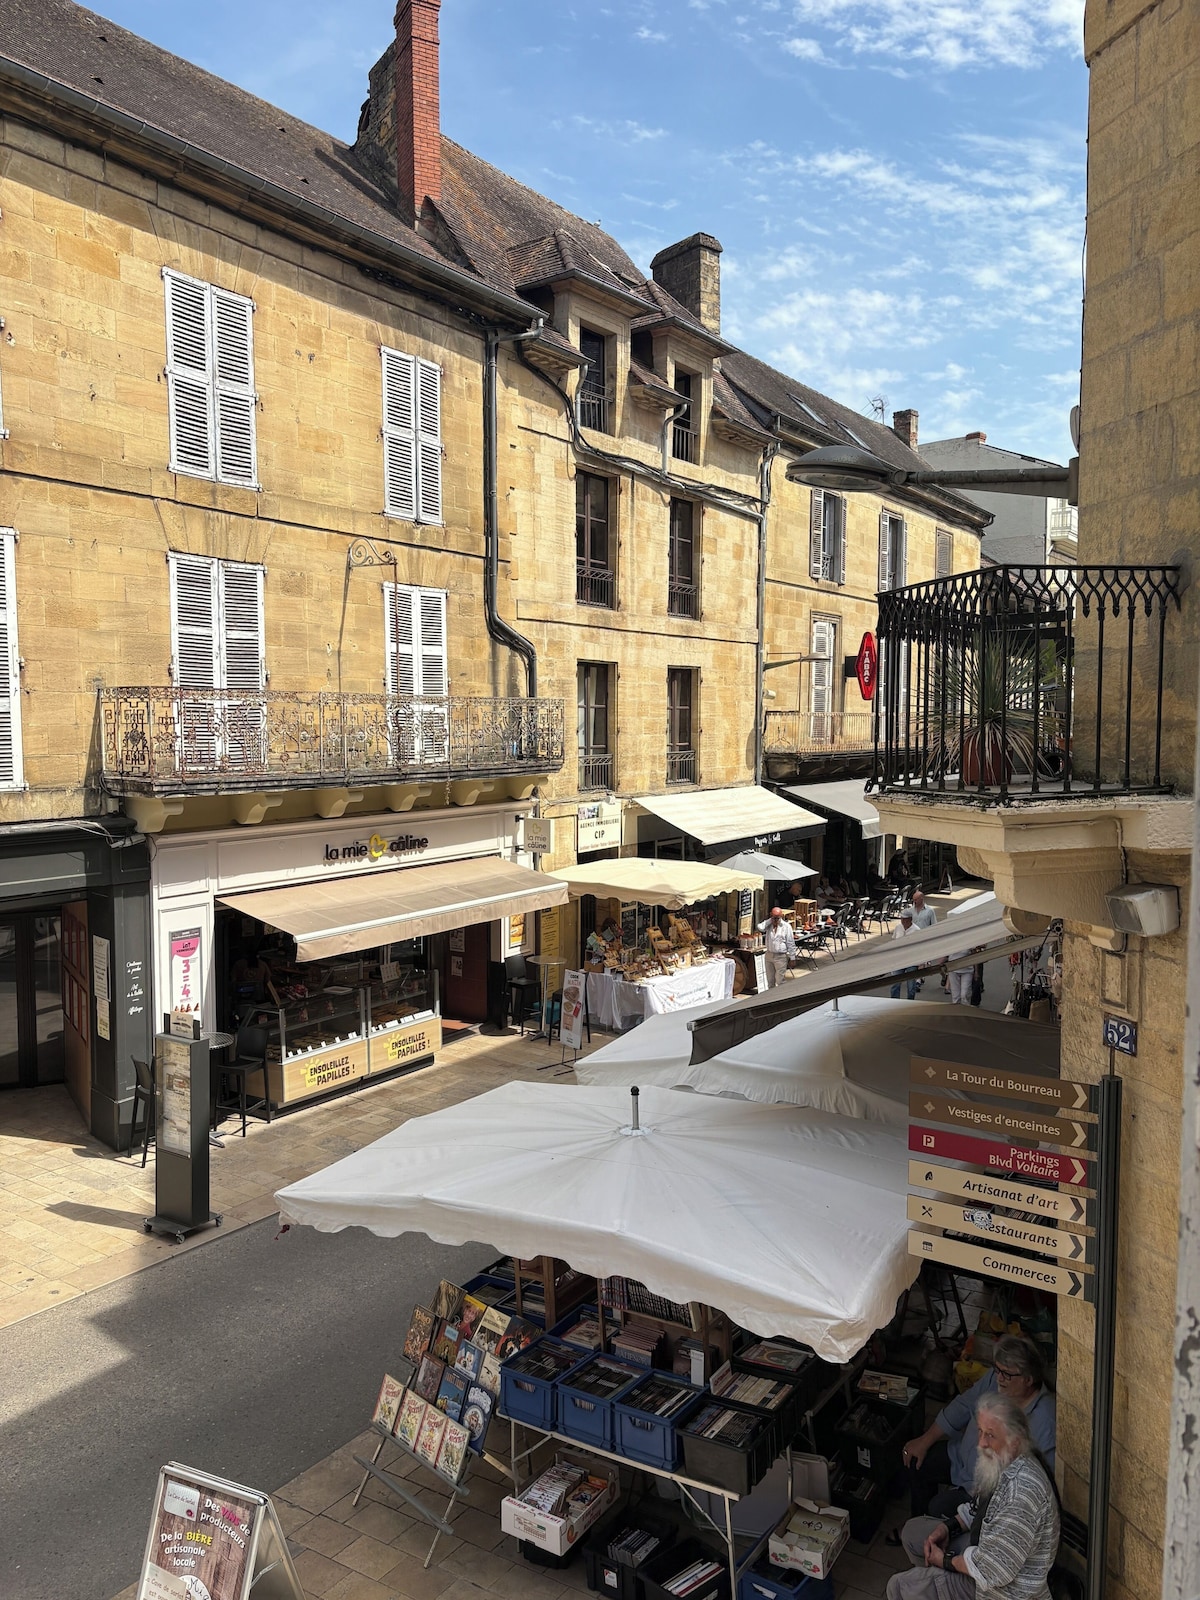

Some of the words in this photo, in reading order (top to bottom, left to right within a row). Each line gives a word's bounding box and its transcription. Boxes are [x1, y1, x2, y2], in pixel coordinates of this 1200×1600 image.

[527, 833, 534, 841] la
[534, 834, 547, 842] mie
[594, 830, 605, 839] CIP
[325, 844, 339, 860] la
[342, 841, 368, 858] mie
[390, 834, 428, 852] câline
[182, 959, 190, 974] 3
[181, 984, 190, 998] 4
[391, 1032, 426, 1050] ENSOLEILLEZ
[1108, 1018, 1130, 1050] 52
[397, 1041, 426, 1059] PAPILLES
[310, 1056, 350, 1076] ENSOLEILLEZ
[316, 1067, 350, 1086] PAPILLES
[946, 1070, 958, 1080] La
[961, 1071, 987, 1086] Tour
[989, 1076, 1004, 1088] du
[1007, 1080, 1061, 1098] Bourreau
[948, 1105, 992, 1124] Vestiges
[994, 1114, 1061, 1136] d'enceintes
[989, 1154, 1012, 1168] Blvd
[1016, 1161, 1060, 1178] Voltaire
[1010, 1148, 1060, 1168] Parkings
[962, 1180, 1023, 1202] Artisanat
[1026, 1193, 1059, 1211] d'art
[981, 1222, 1058, 1248] estaurants
[982, 1256, 1057, 1285] Commerces
[204, 1498, 220, 1512] Des
[240, 1523, 250, 1537] de
[160, 1533, 172, 1543] De
[174, 1531, 182, 1540] la
[186, 1528, 213, 1546] BIÈRE
[200, 1512, 246, 1549] producteurs
[164, 1544, 206, 1556] artisanale
[173, 1557, 196, 1568] locale
